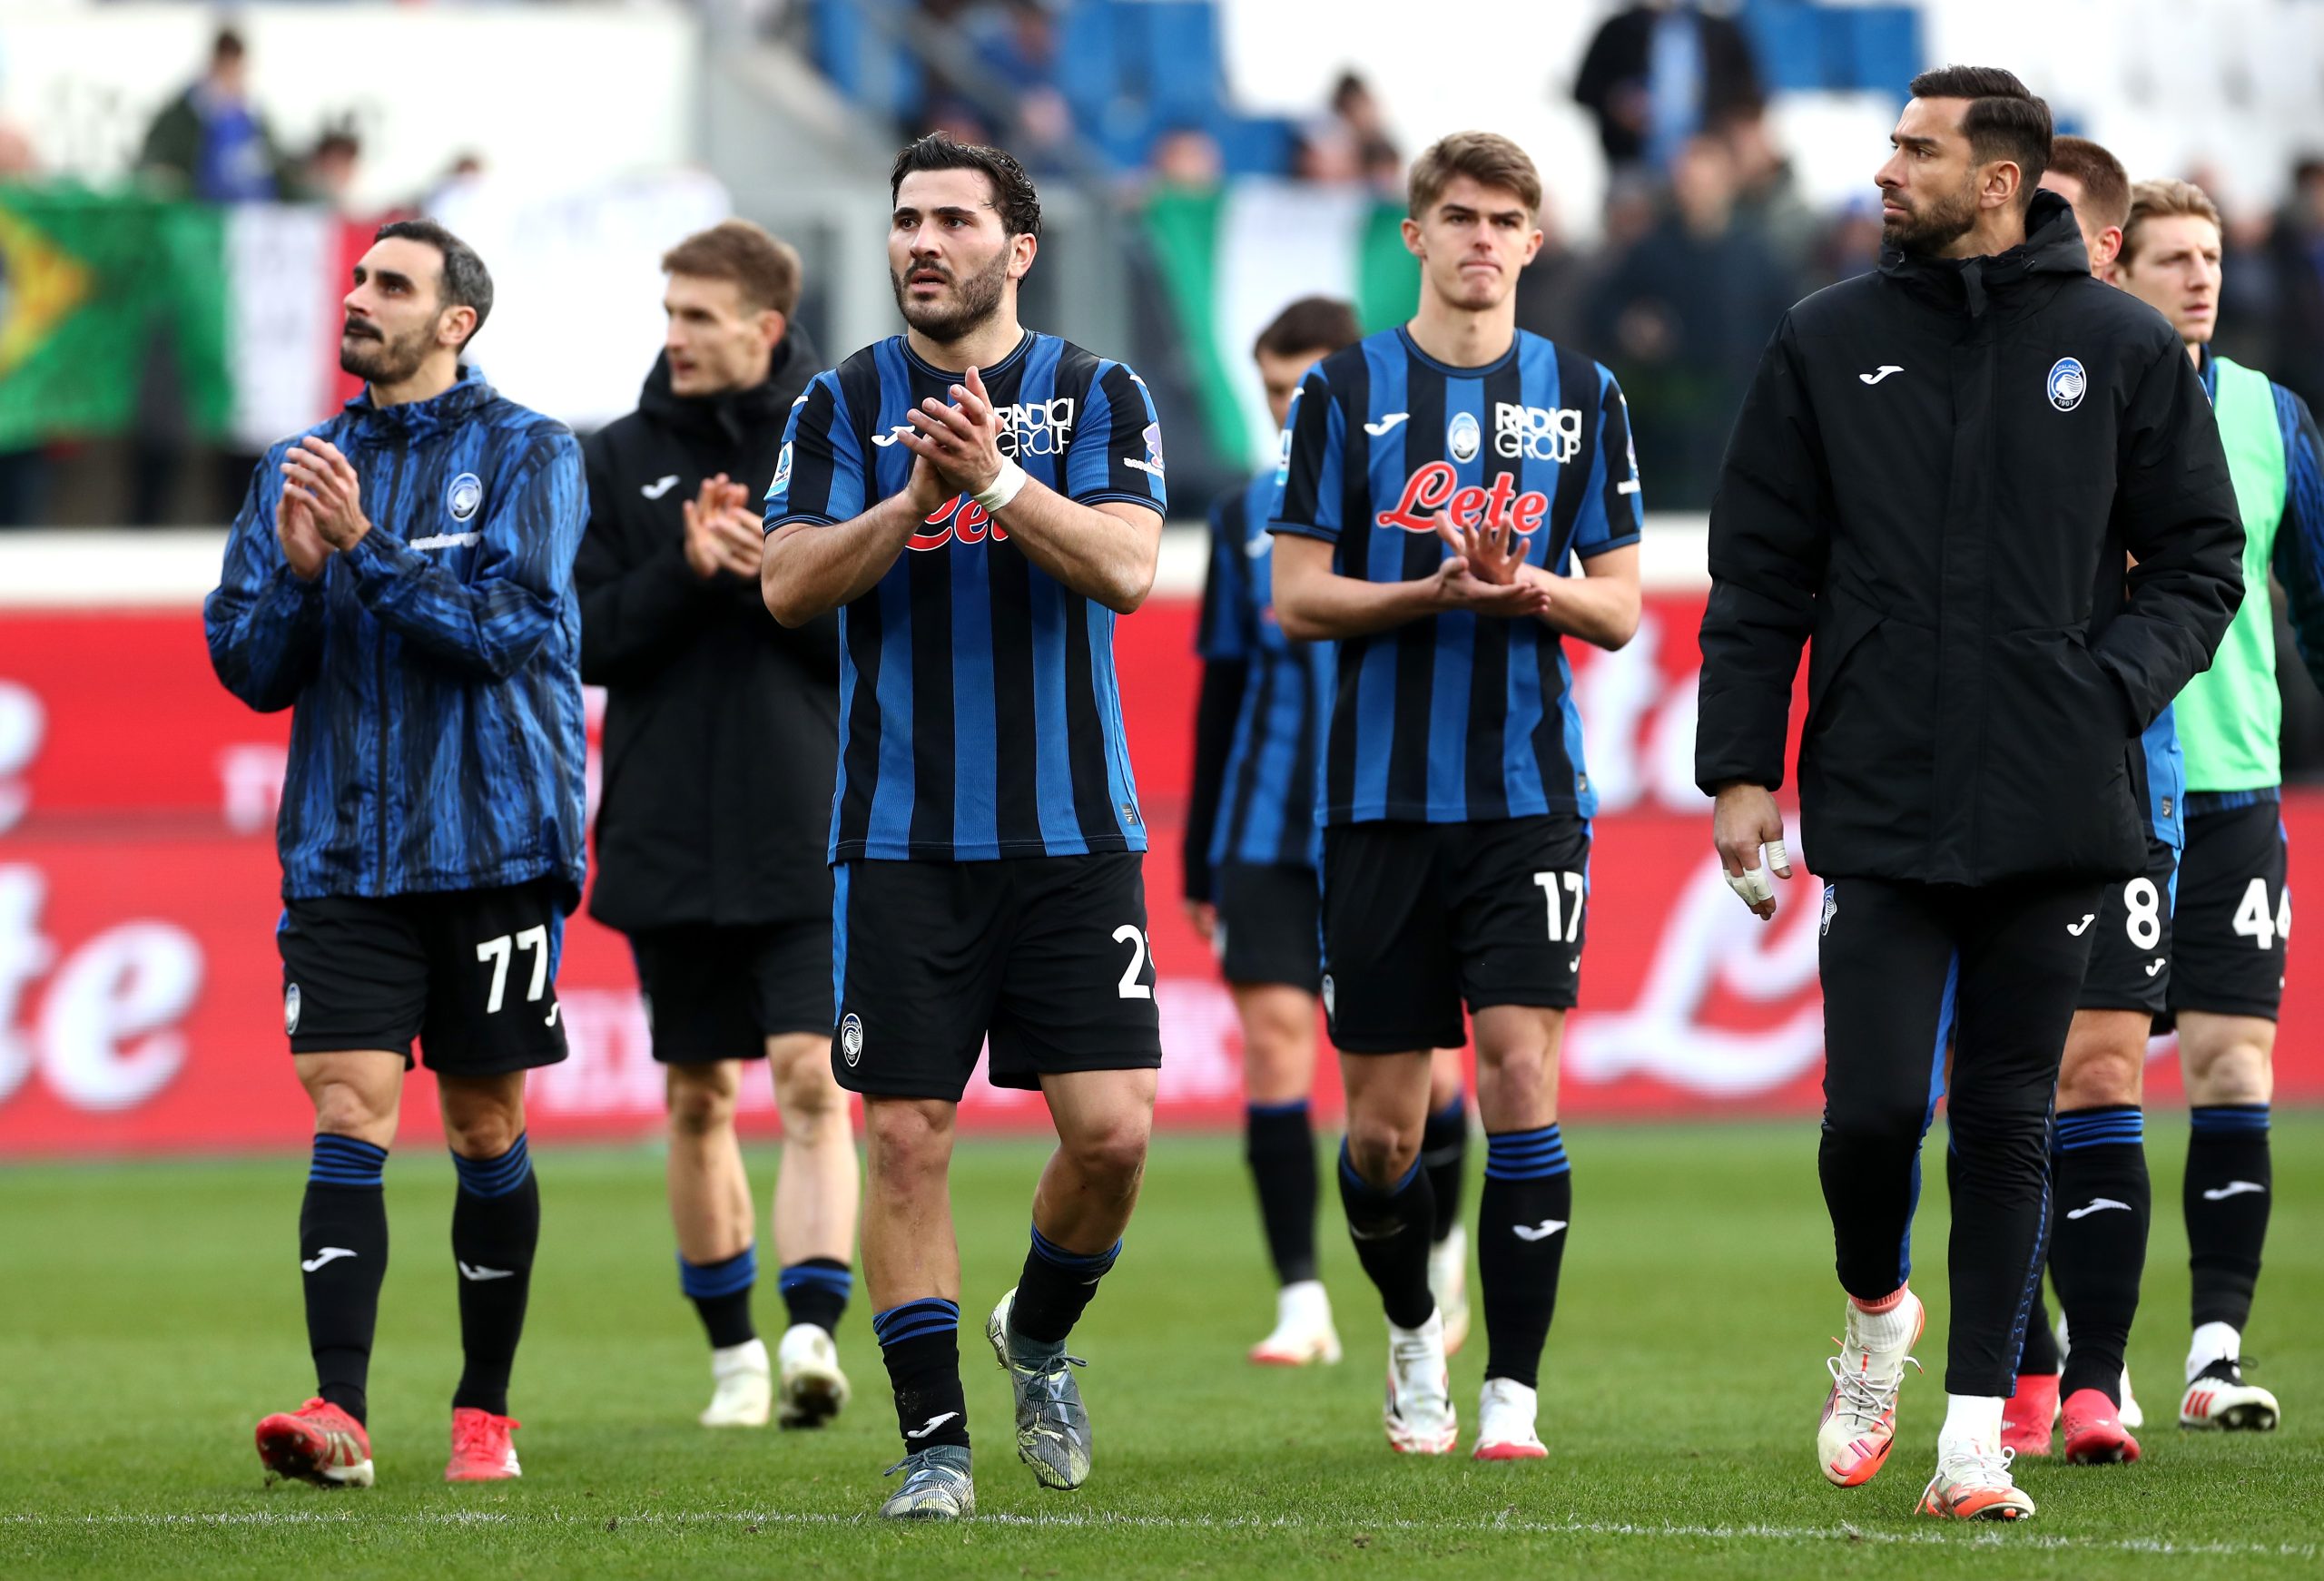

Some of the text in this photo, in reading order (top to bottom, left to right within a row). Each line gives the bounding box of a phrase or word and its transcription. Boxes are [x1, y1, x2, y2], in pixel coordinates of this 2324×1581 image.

[994, 398, 1074, 432] RADICI
[1494, 401, 1582, 440] RADICI
[1494, 428, 1581, 464] GROUP
[1375, 460, 1558, 535] Lete
[1533, 871, 1584, 943] 17
[2123, 877, 2161, 950] 8
[477, 924, 548, 1014] 77
[1111, 924, 1157, 1005] 2
